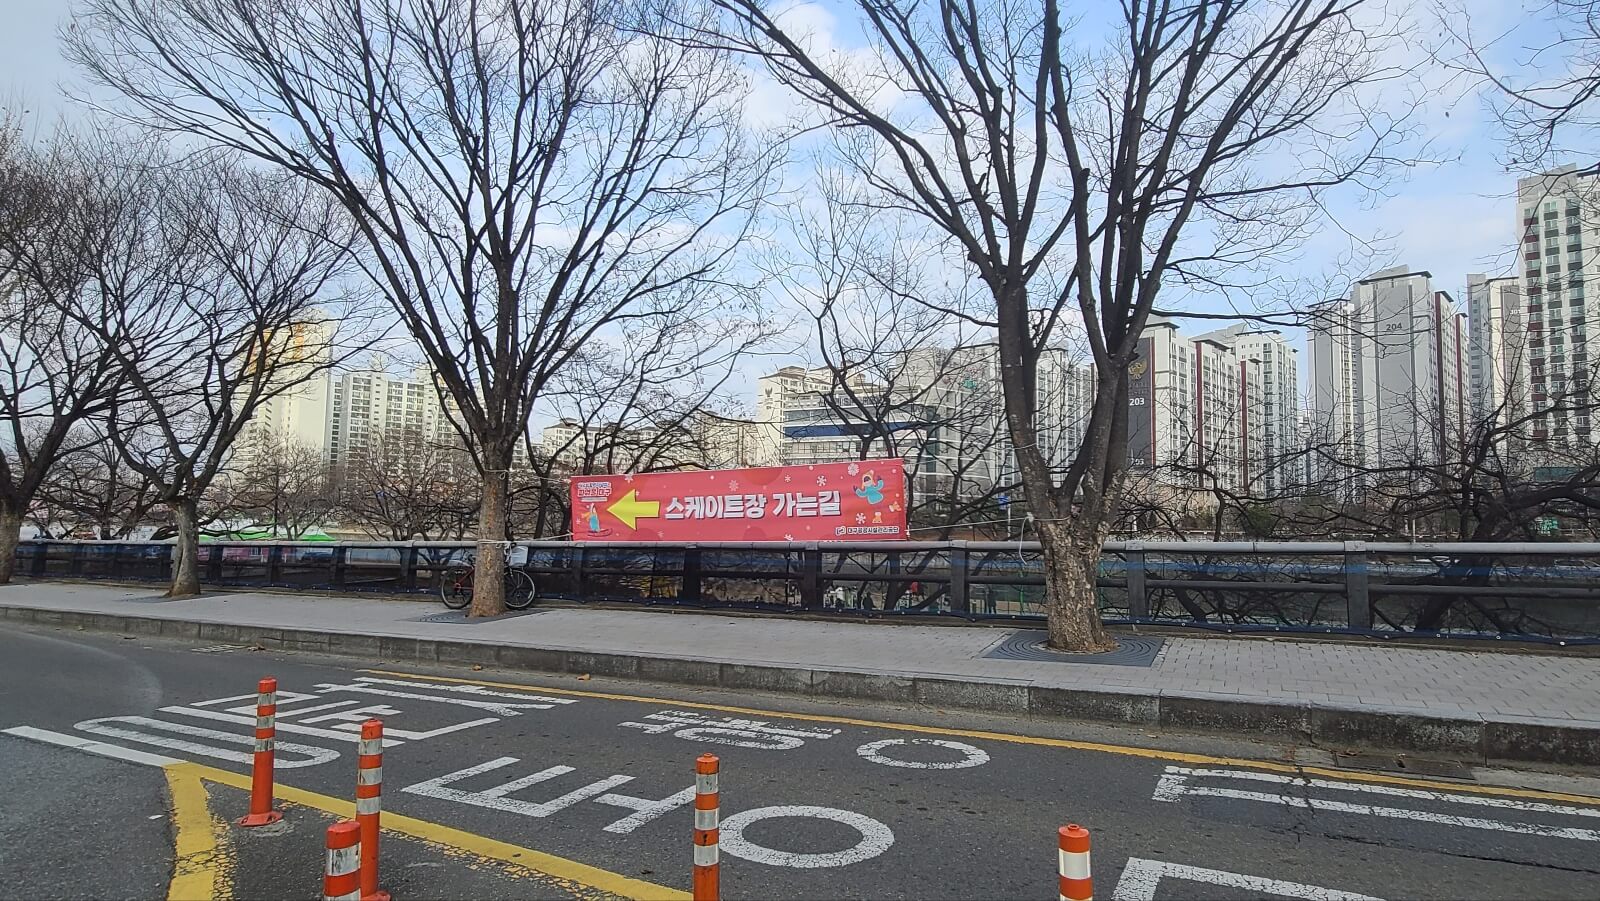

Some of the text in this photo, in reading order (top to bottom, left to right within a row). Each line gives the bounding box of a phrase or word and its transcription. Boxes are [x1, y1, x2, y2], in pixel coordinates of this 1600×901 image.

[1386, 322, 1402, 330] 204
[1130, 397, 1145, 406] 203
[665, 491, 841, 519] 스케이트장 가는길
